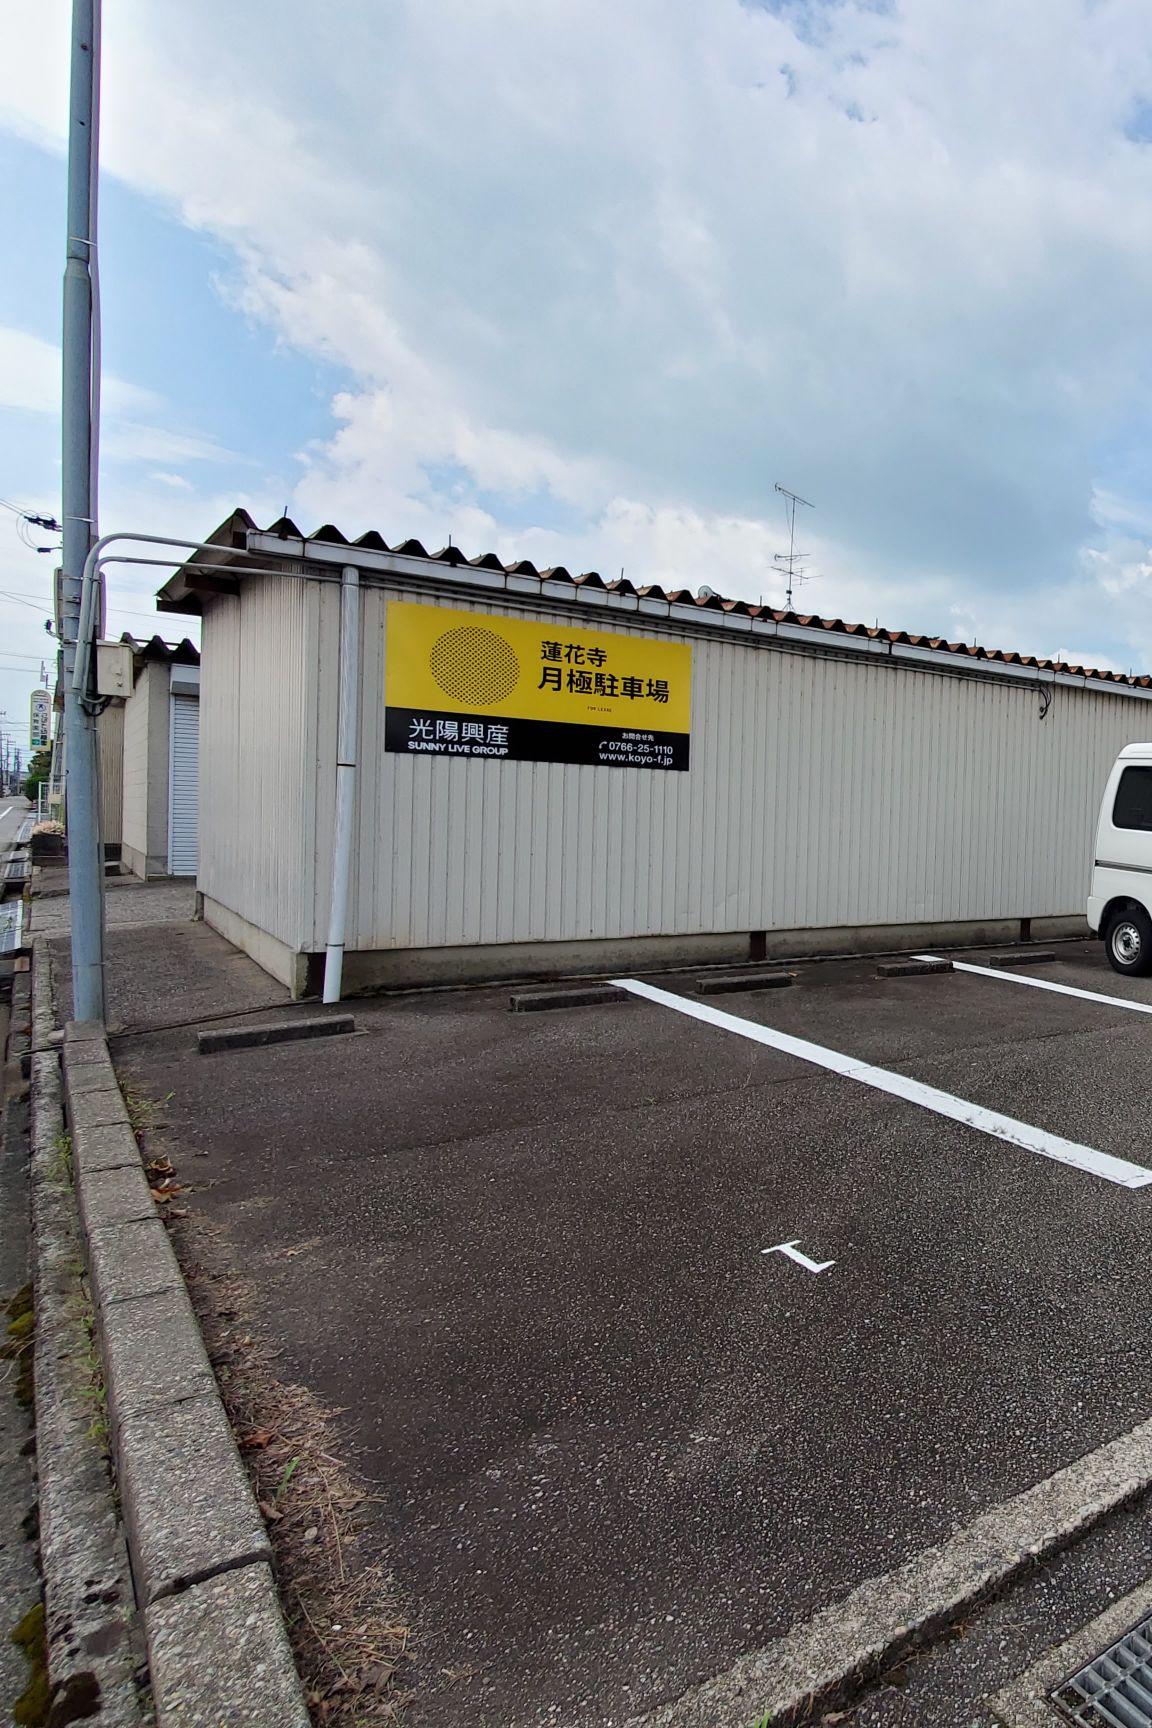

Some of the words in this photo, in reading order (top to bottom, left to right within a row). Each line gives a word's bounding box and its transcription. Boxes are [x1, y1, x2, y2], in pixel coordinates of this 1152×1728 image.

[540, 640, 608, 668] 蓮花寺
[537, 666, 670, 704] 月極駐車場
[408, 718, 510, 746] 光陽興産
[621, 732, 655, 742] お問合せ先
[407, 740, 447, 752] SUNNY
[448, 743, 471, 753] LIVE
[472, 745, 509, 756] GROUP
[599, 752, 673, 766] www.koyo-f.jp
[608, 741, 674, 755] 0766-25-1110
[760, 1239, 836, 1273] 1
